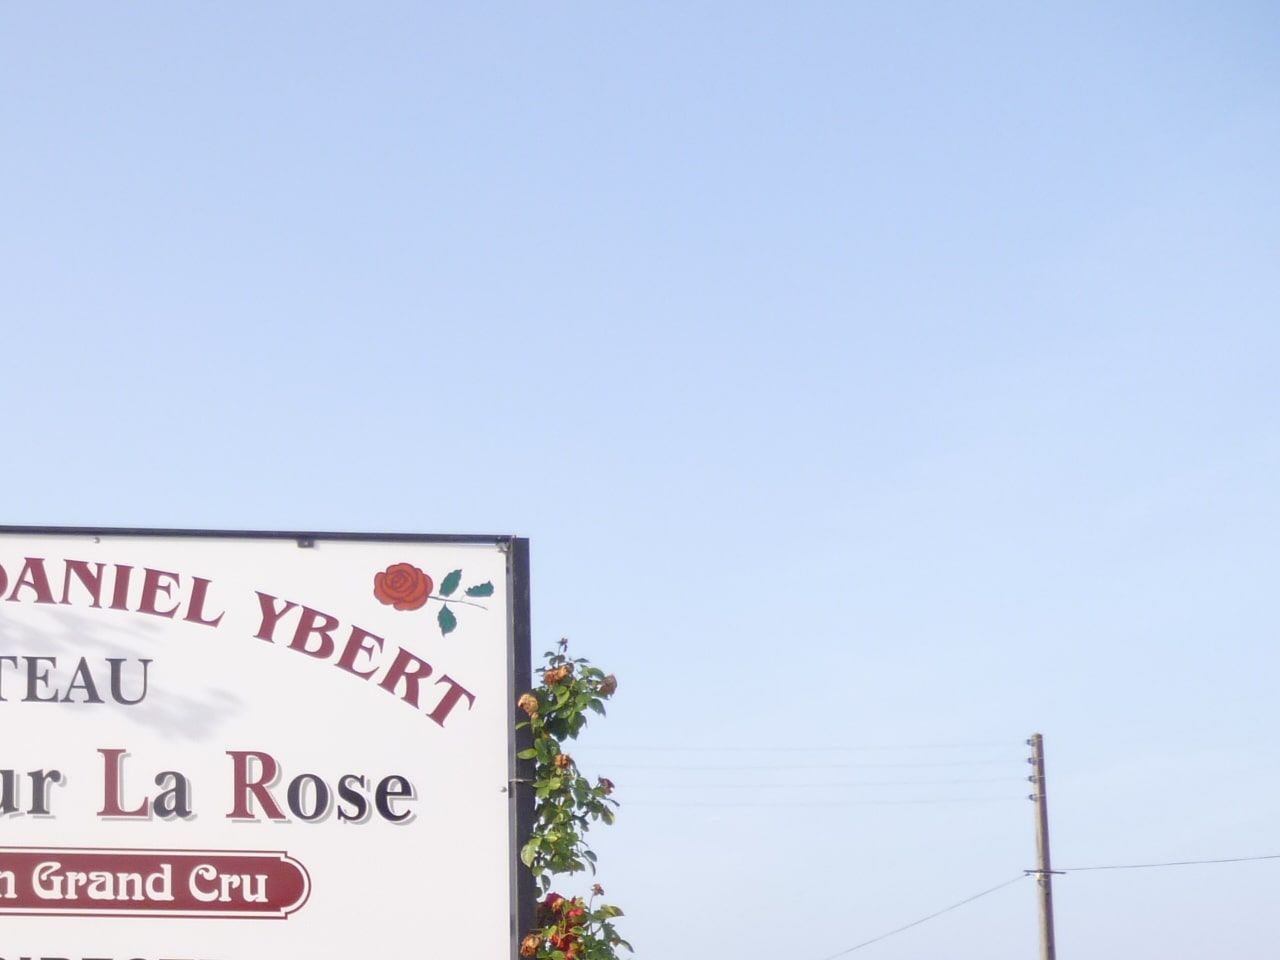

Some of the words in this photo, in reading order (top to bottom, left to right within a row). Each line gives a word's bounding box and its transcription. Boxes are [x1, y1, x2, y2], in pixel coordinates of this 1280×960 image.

[251, 590, 477, 728] YBERT
[96, 748, 194, 821] La
[225, 750, 417, 824] Rose
[31, 860, 175, 901] Grand
[187, 863, 269, 903] Cru
